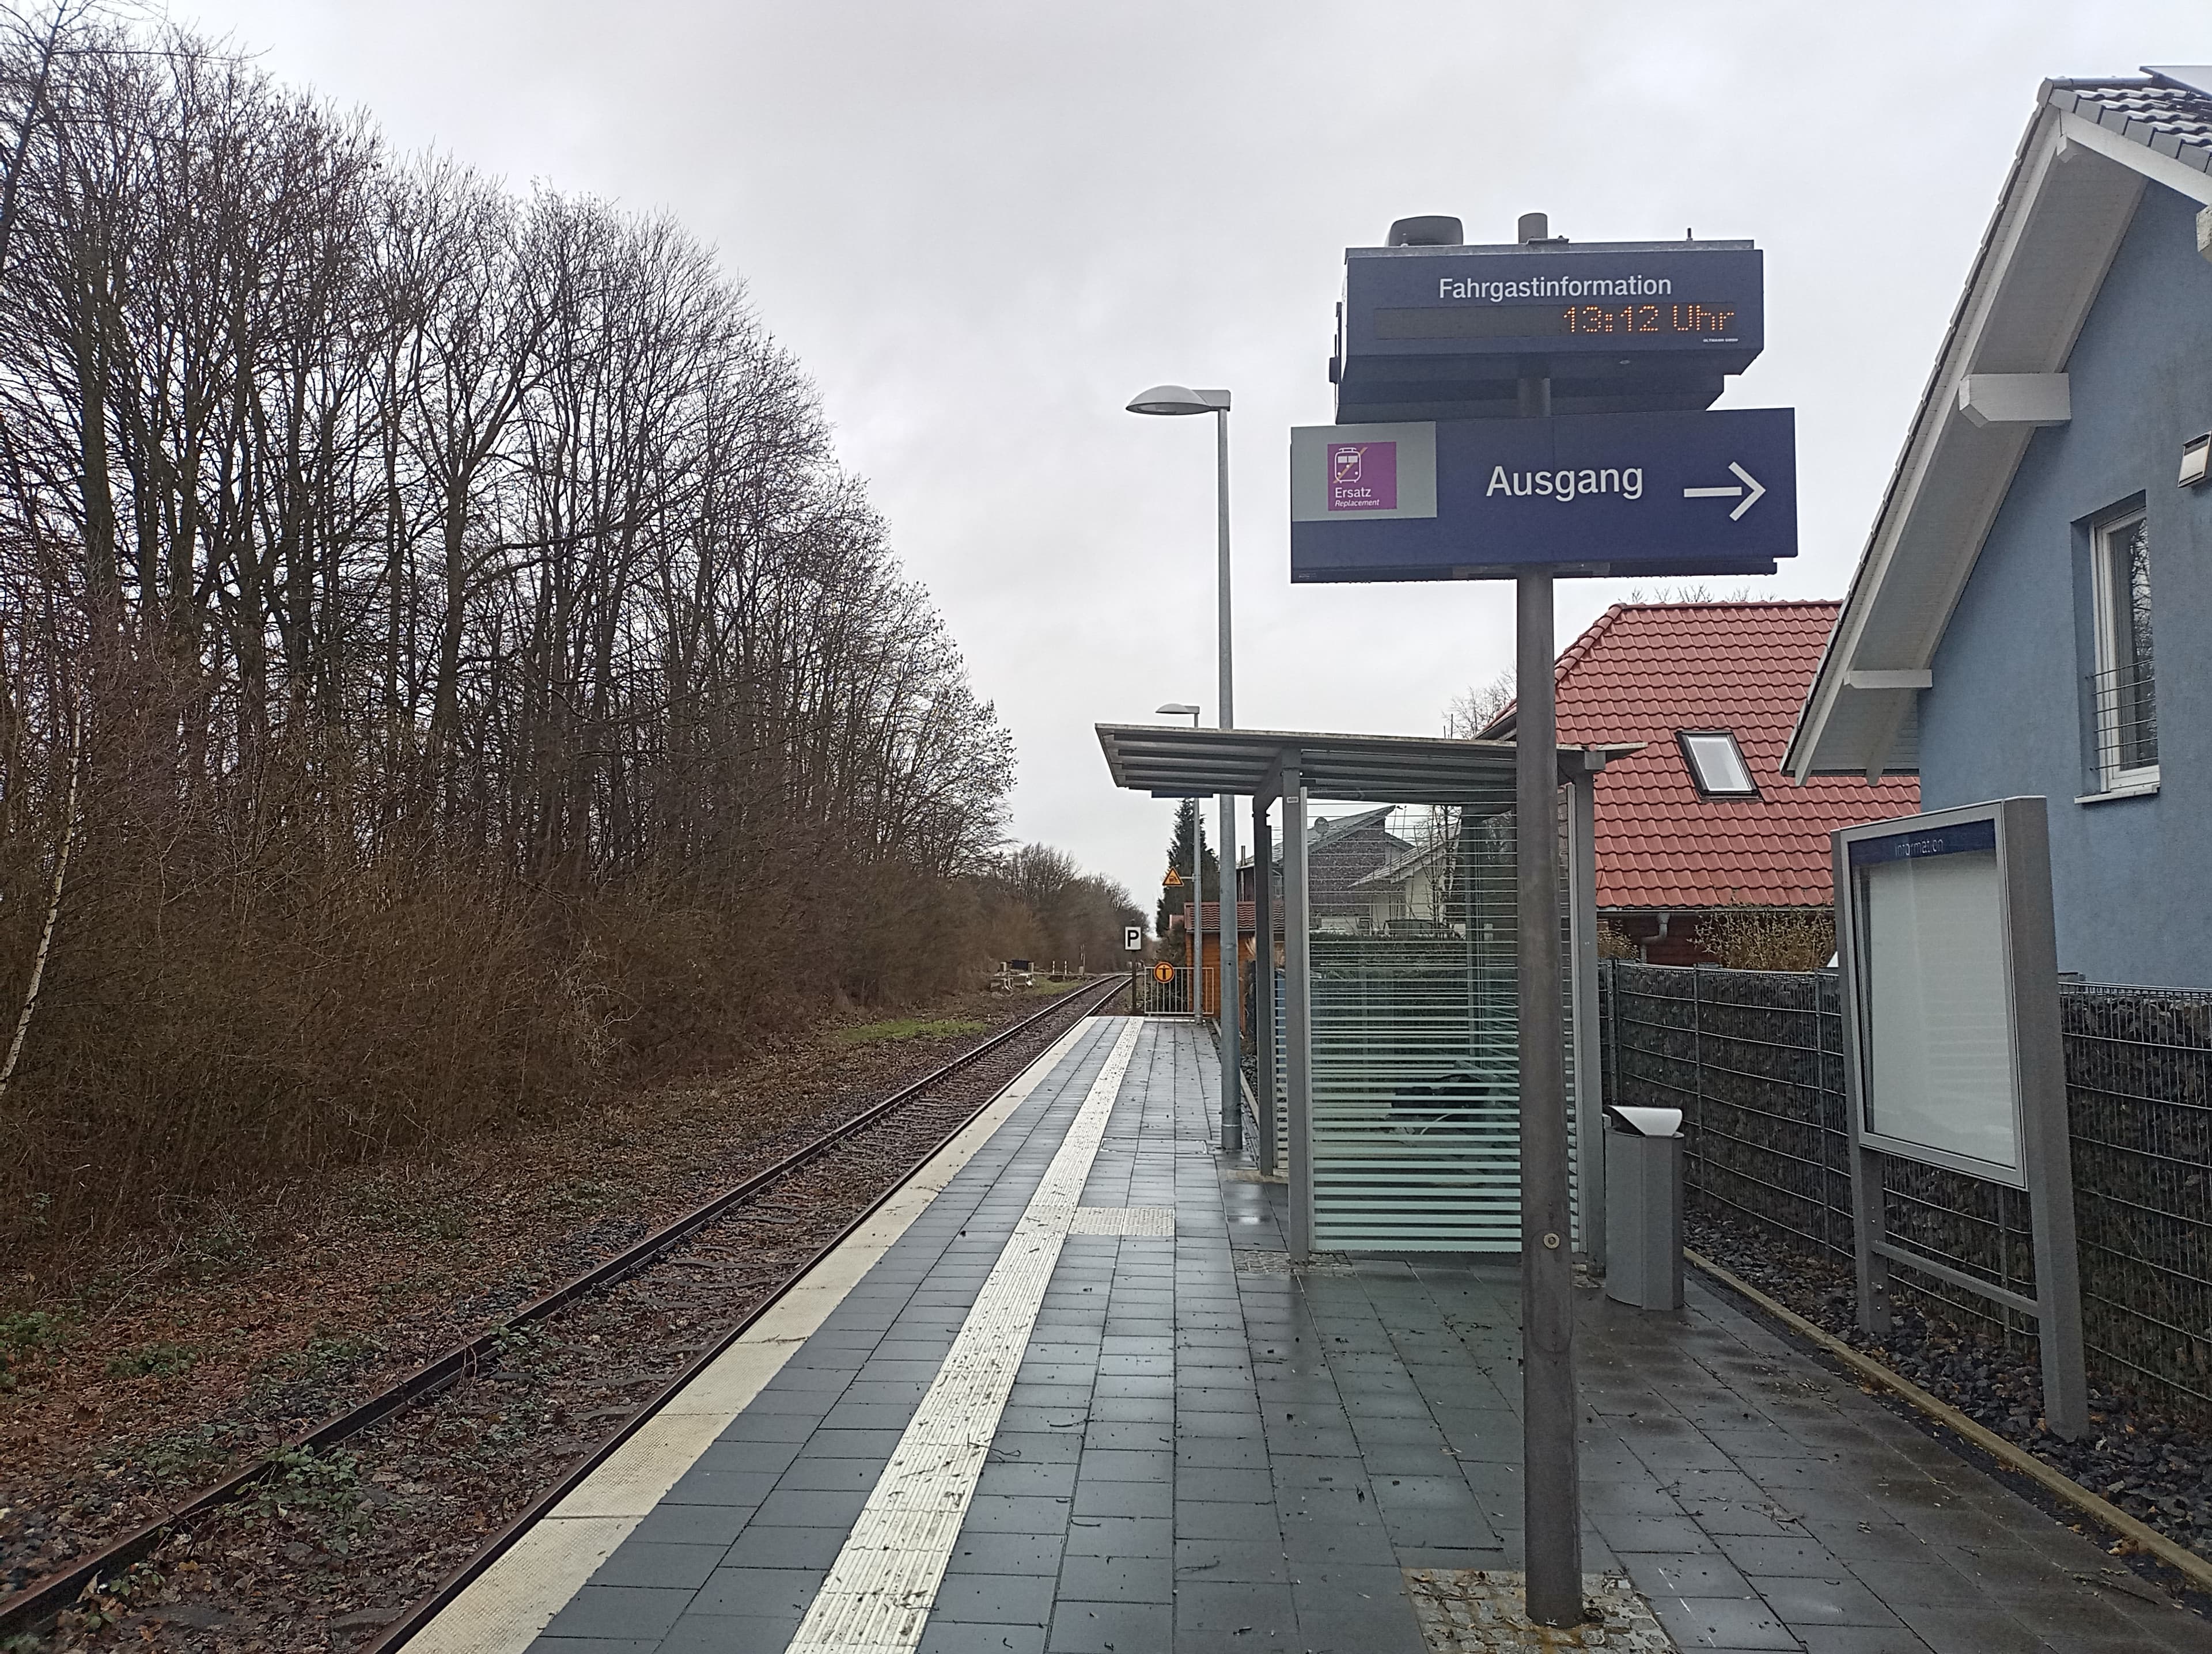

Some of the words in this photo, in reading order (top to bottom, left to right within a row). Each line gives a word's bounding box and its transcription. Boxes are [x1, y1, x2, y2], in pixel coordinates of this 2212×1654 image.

[1440, 275, 1672, 302] Fahrgastinformation
[1563, 304, 1660, 333] 13:12
[1673, 304, 1736, 331] Uhr
[1335, 487, 1371, 498] Ersatz
[1486, 465, 1643, 502] Ausgang
[1335, 499, 1380, 508] Replacement
[1127, 930, 1139, 947] P
